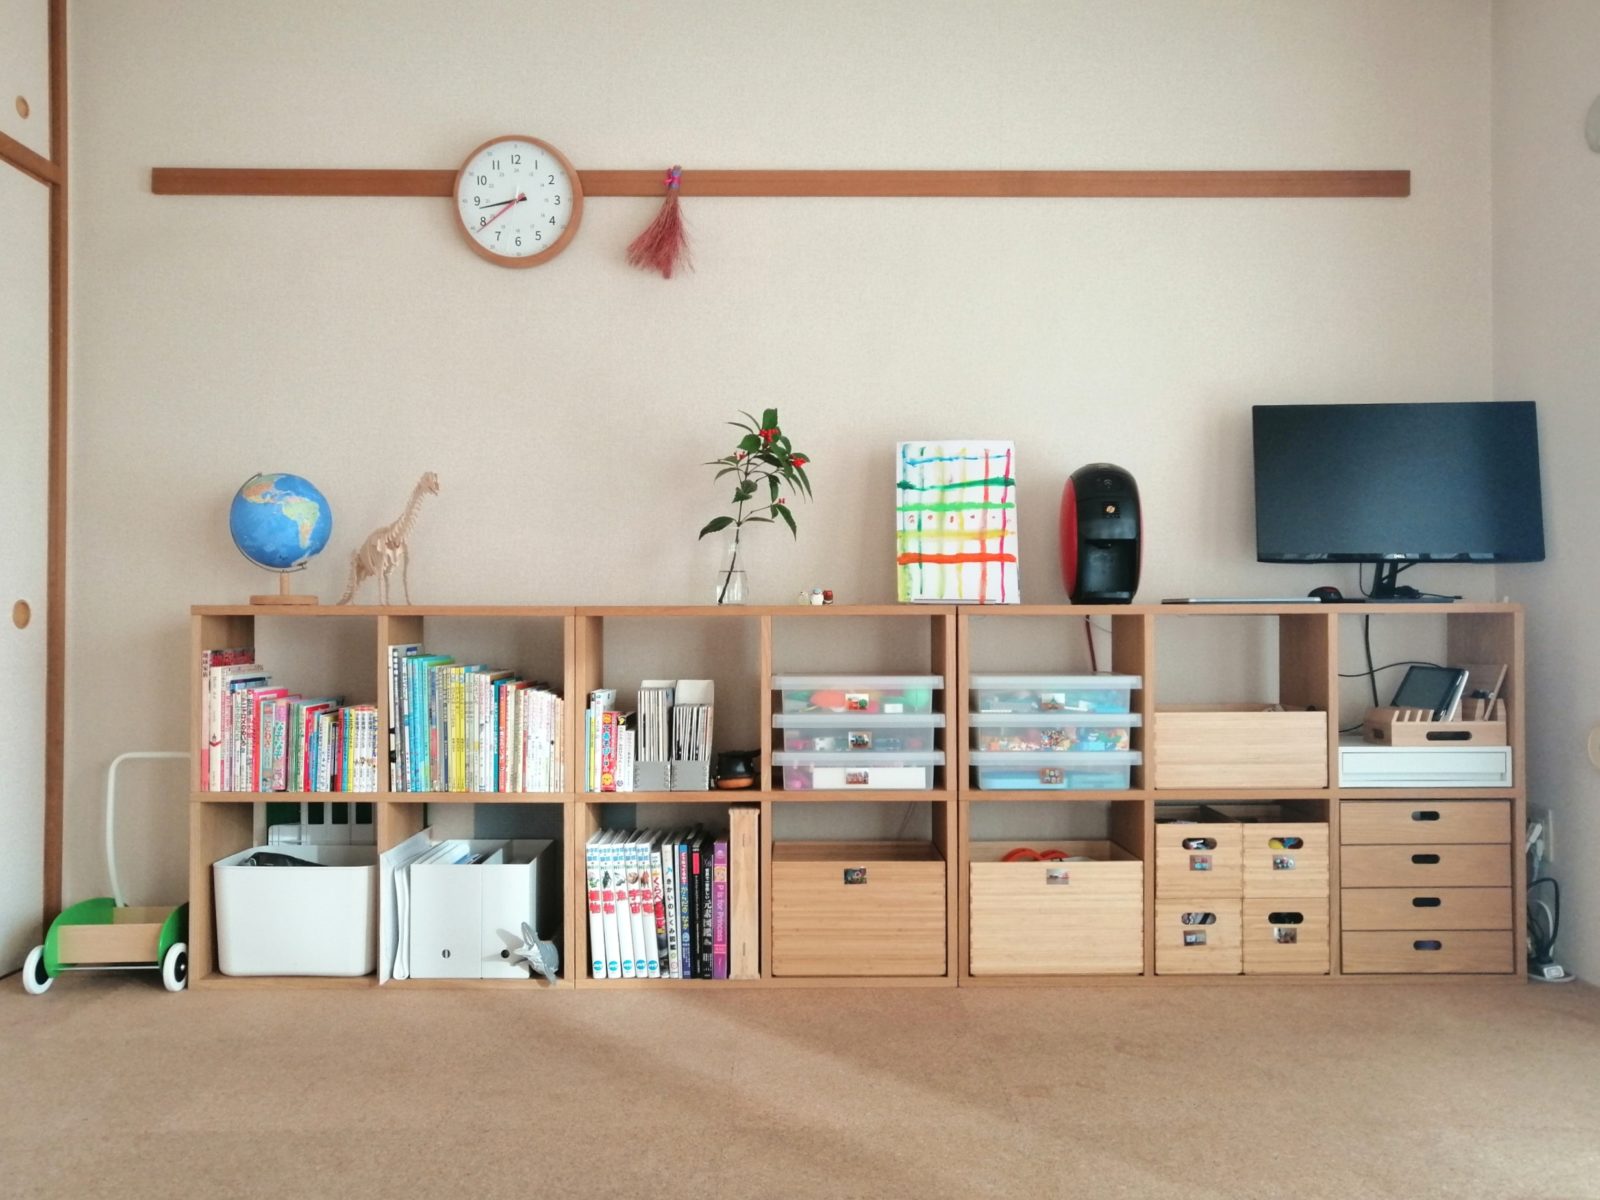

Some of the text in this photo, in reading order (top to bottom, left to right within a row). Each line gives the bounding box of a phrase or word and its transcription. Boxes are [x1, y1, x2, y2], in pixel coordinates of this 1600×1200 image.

[511, 154, 521, 165] 12
[492, 160, 500, 170] 11
[477, 175, 487, 186] 10
[548, 175, 555, 185] 2
[474, 196, 481, 206] 9
[554, 195, 561, 205] 3
[480, 216, 487, 227] 8
[549, 216, 556, 225] 4
[495, 231, 501, 241] 7
[535, 230, 541, 240] 5
[515, 237, 522, 246] 6
